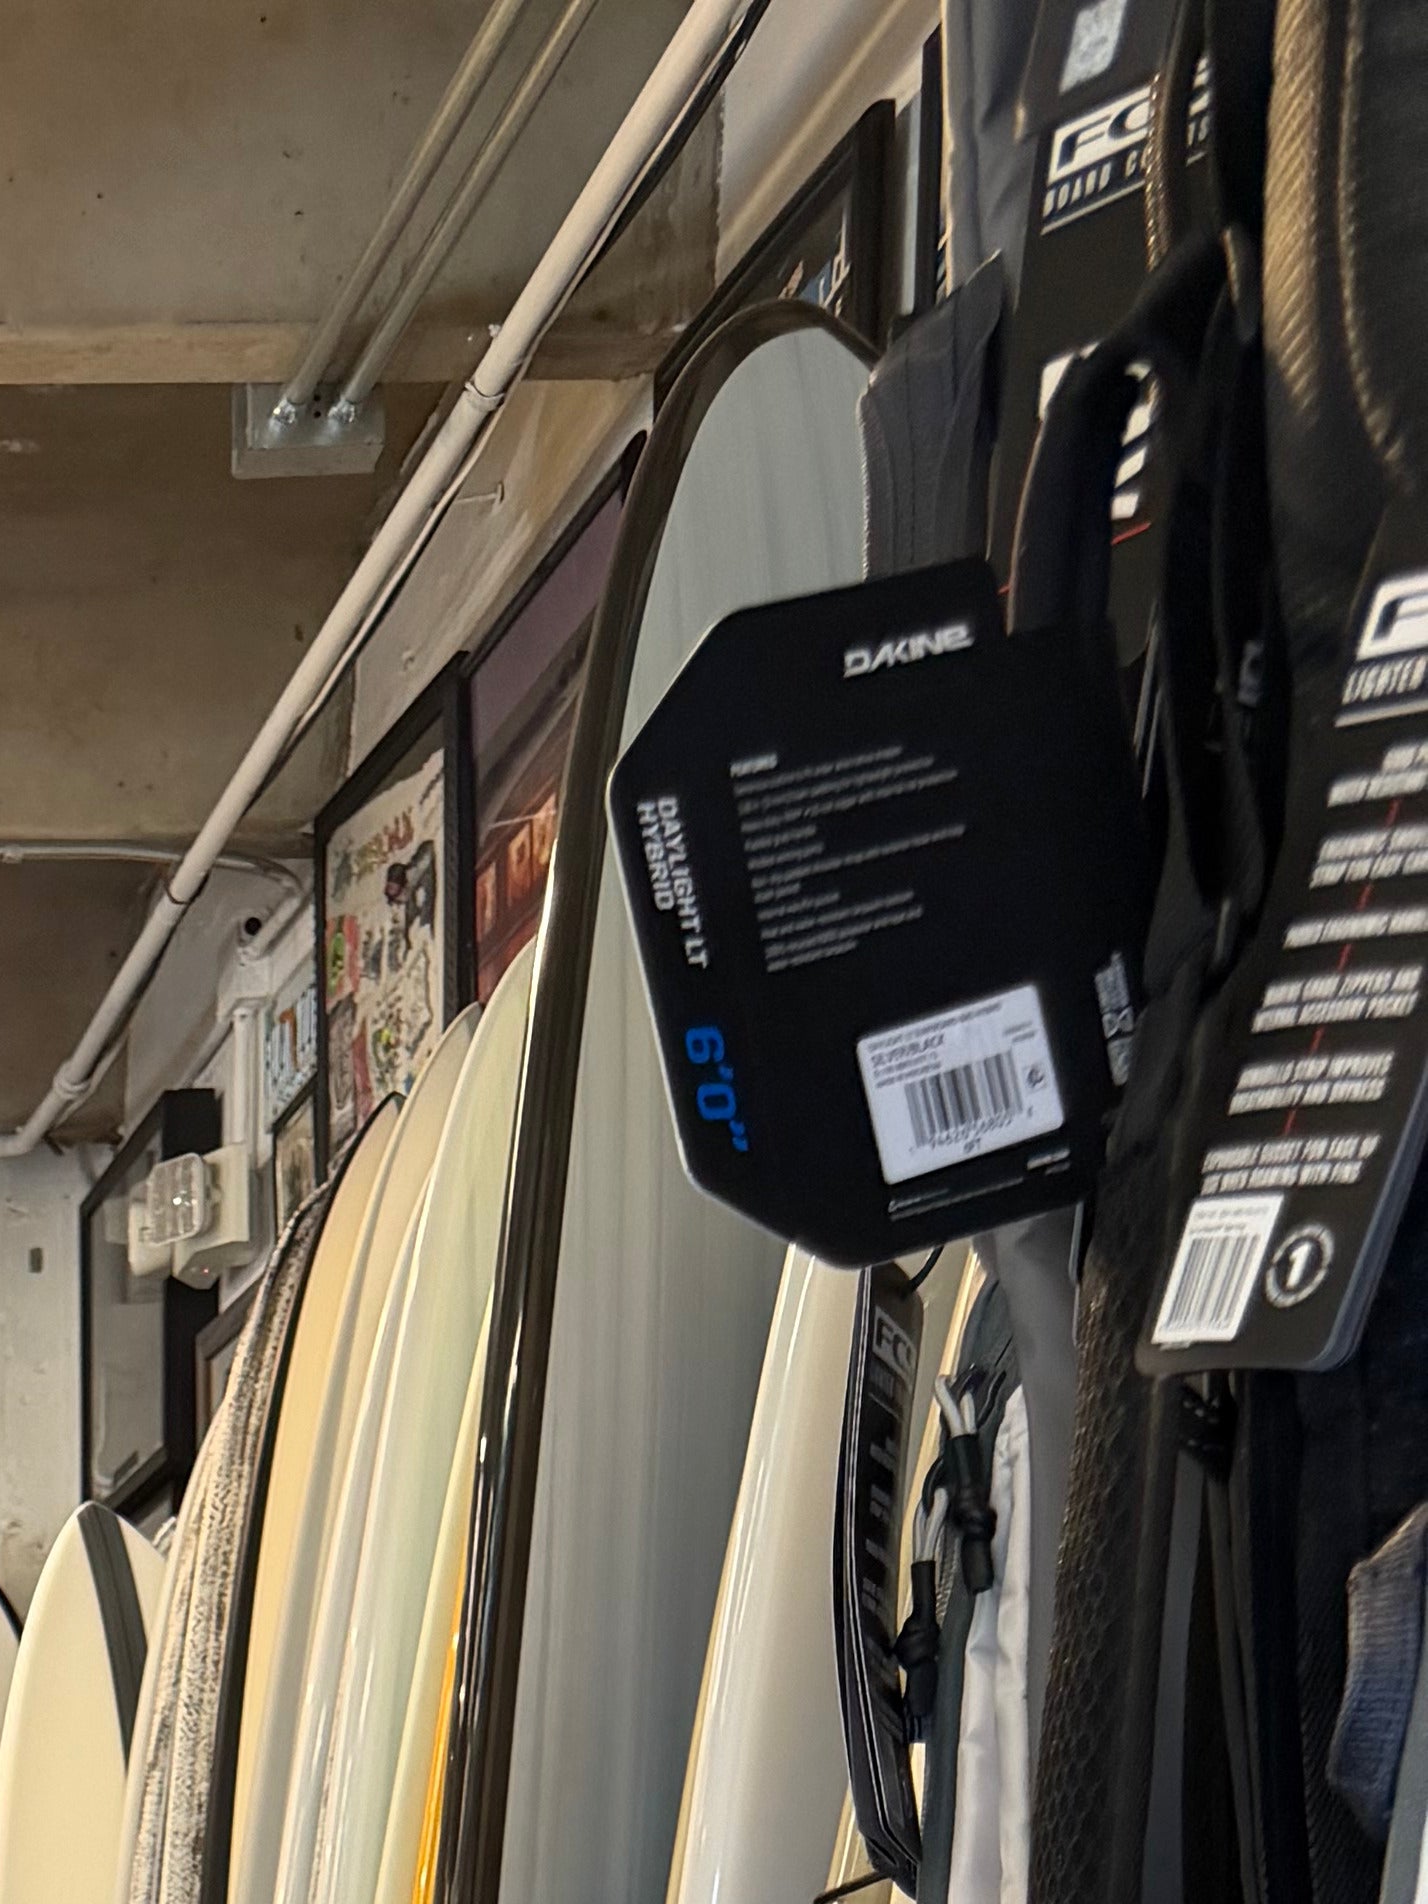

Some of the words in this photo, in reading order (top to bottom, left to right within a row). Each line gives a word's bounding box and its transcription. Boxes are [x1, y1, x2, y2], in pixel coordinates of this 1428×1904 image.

[843, 623, 976, 679] DAKINE
[636, 801, 675, 912] HYBRID
[657, 797, 701, 934] DAYLIGHT
